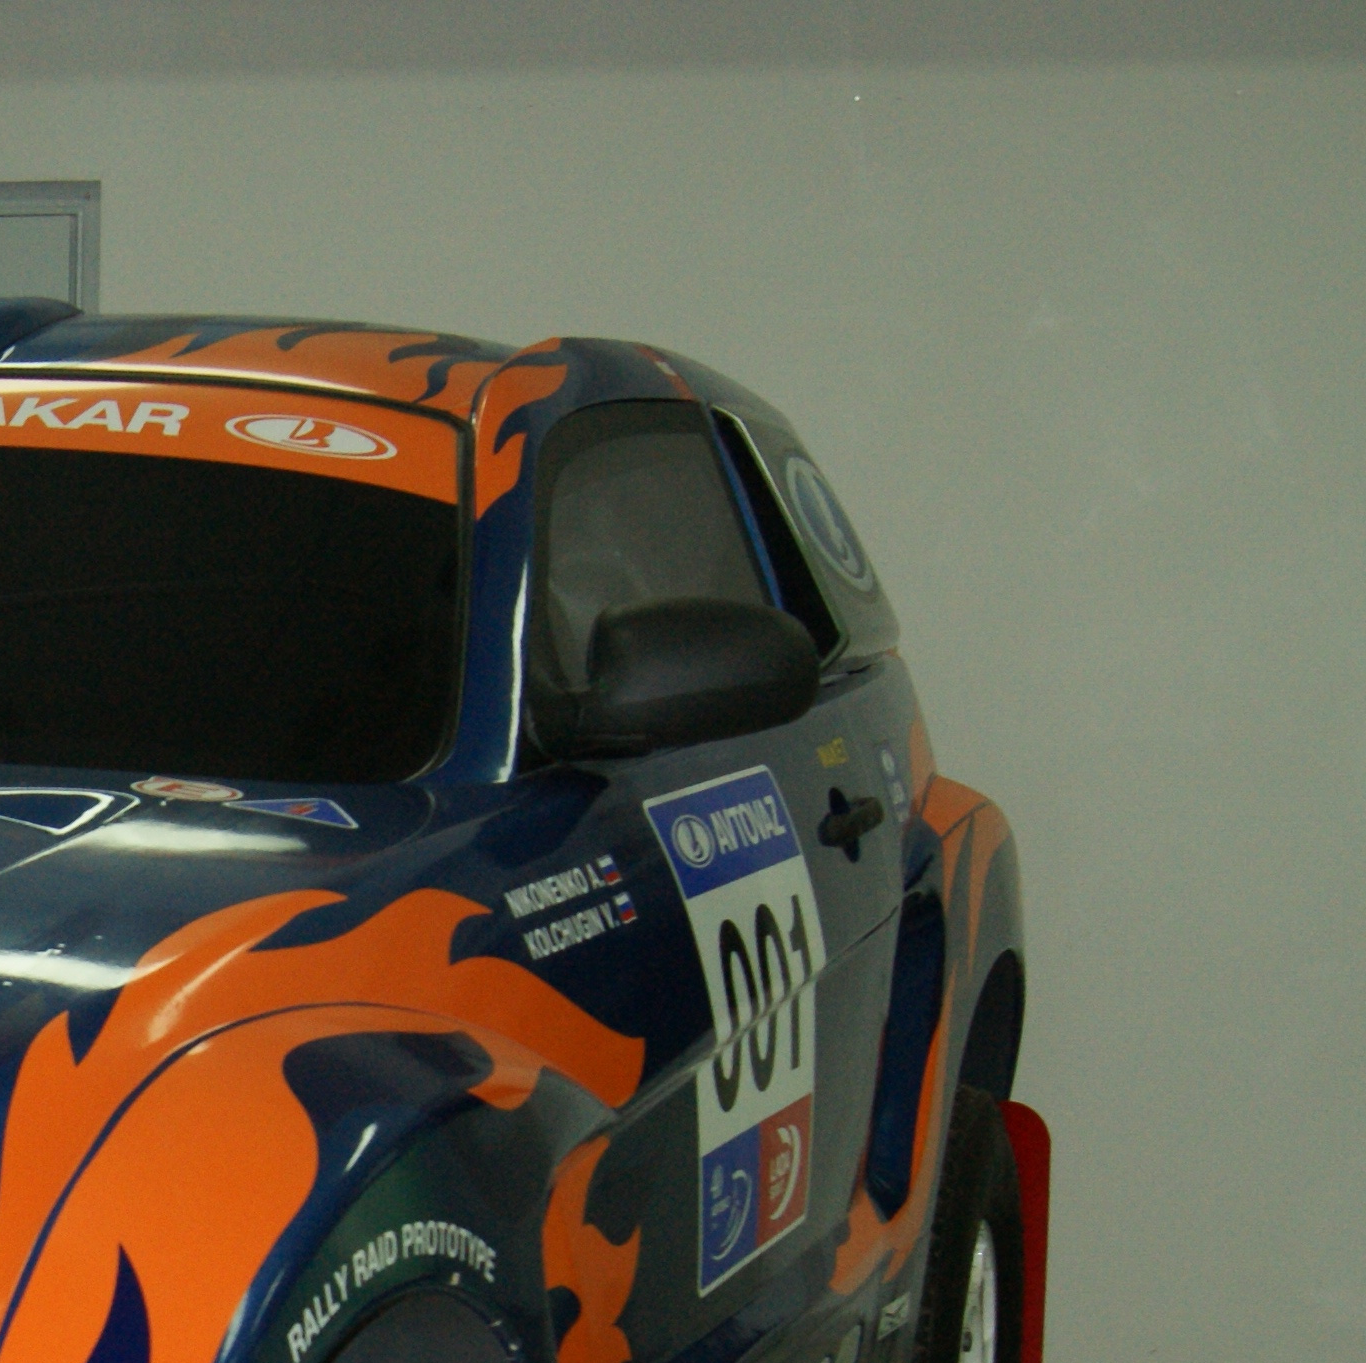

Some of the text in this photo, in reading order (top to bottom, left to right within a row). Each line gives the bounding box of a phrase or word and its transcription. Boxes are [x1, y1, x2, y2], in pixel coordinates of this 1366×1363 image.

[709, 795, 787, 855] AVTOVAZ
[715, 894, 814, 1113] 001
[352, 1230, 398, 1288] RAID
[401, 1220, 497, 1283] PROTOTYPE
